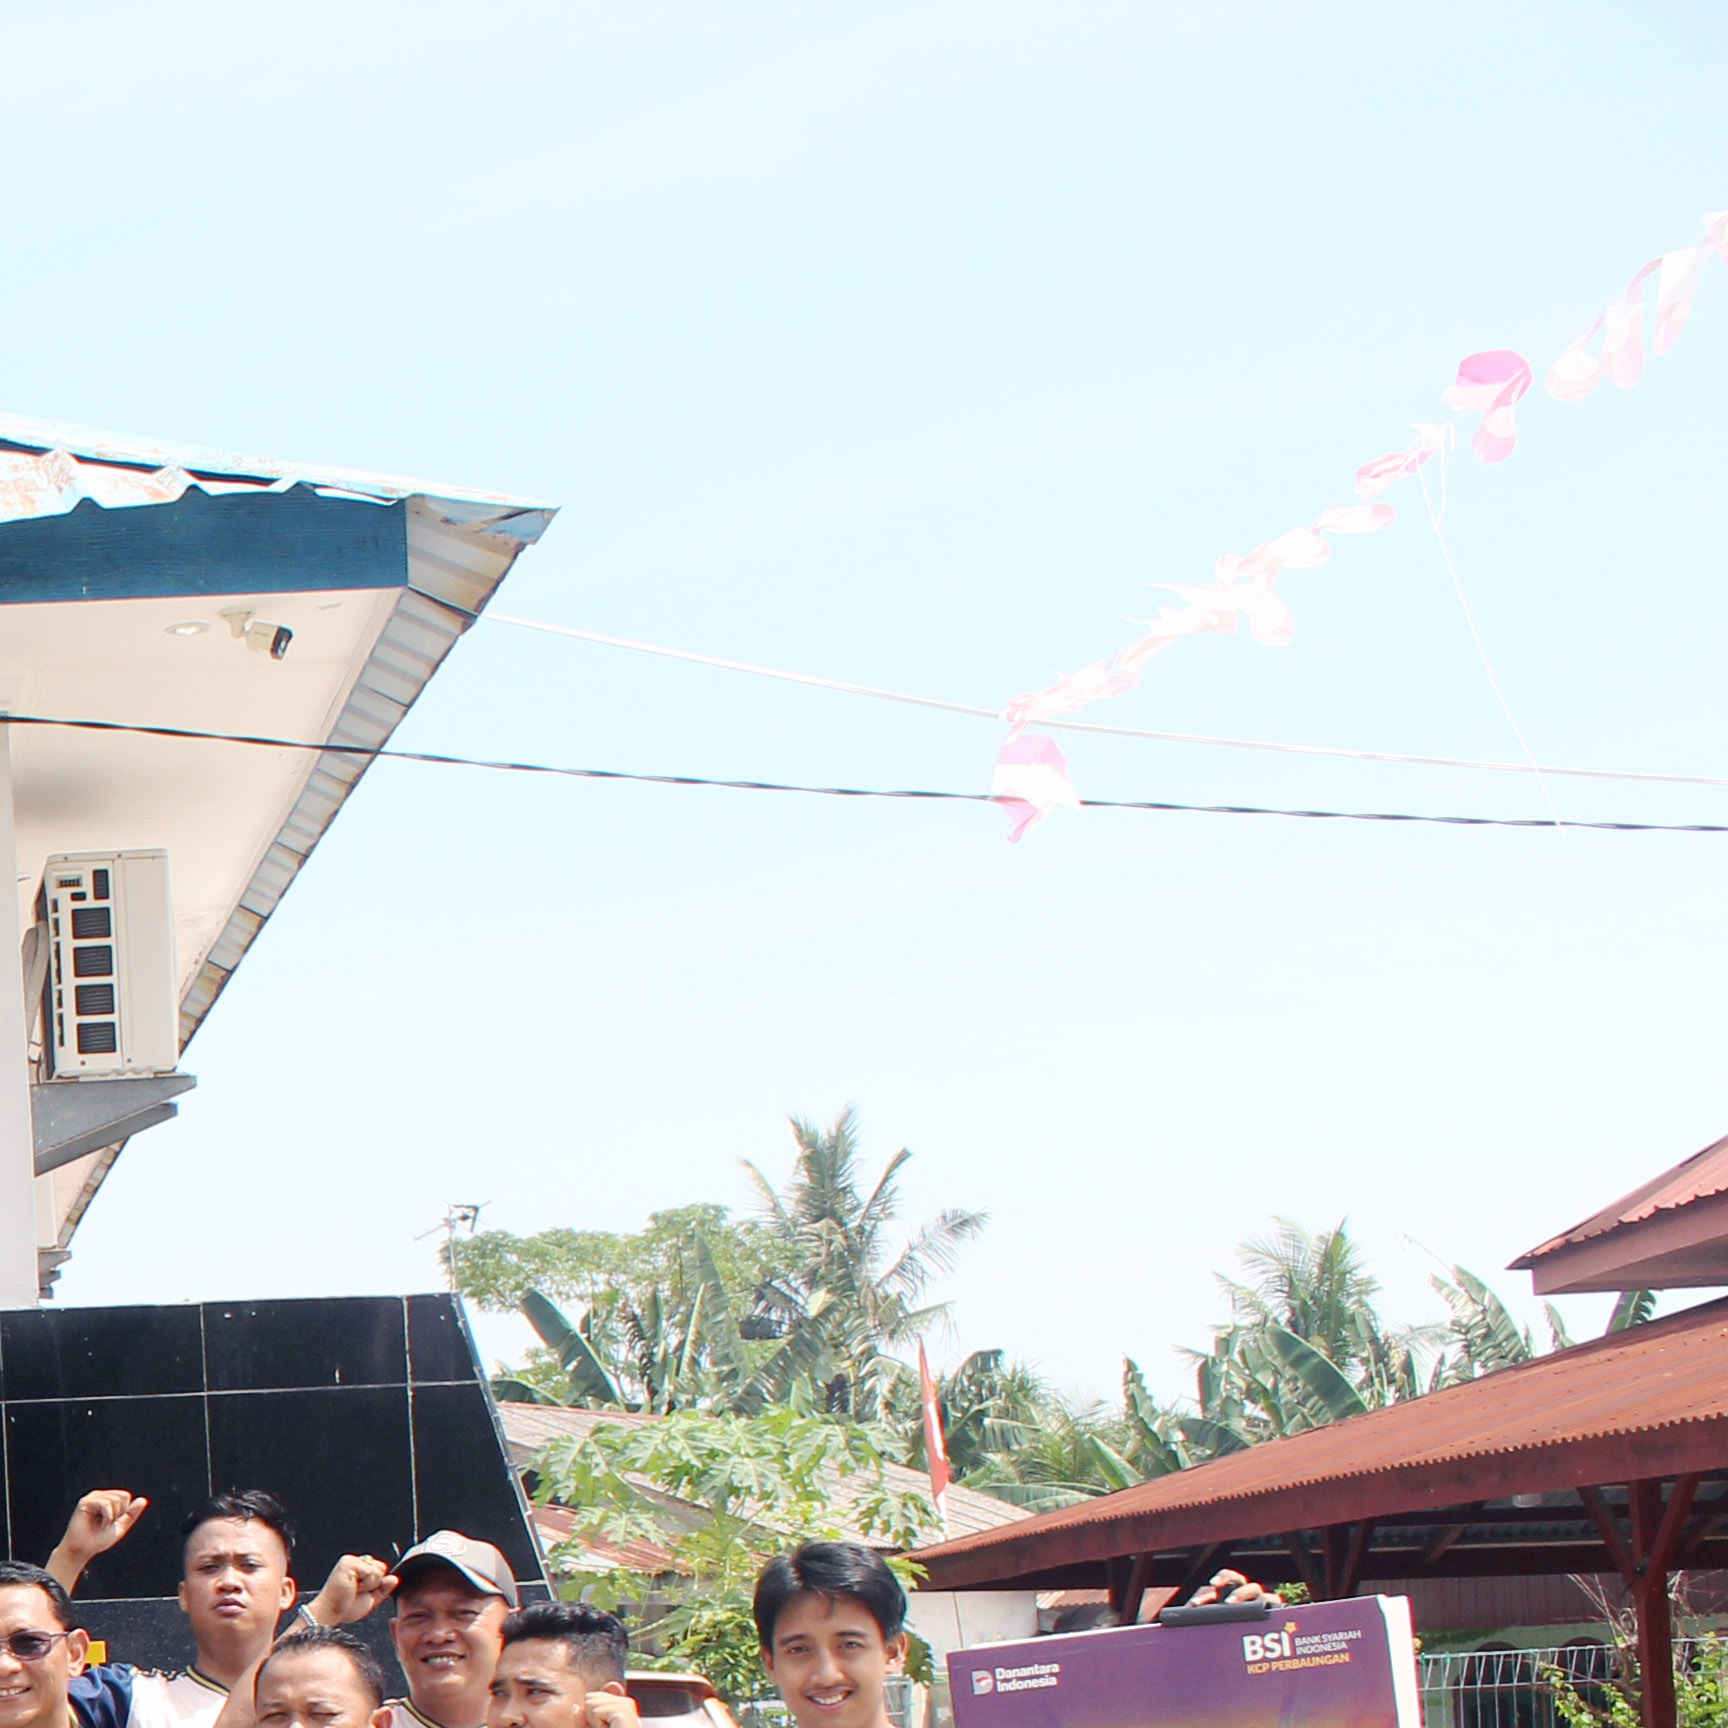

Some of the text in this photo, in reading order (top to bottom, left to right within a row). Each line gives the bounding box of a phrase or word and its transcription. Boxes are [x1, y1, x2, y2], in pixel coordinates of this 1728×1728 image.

[1242, 1631, 1292, 1662] BSI
[1294, 1630, 1362, 1646] BANK SYARIAH
[1296, 1641, 1348, 1655] INDONESIA
[994, 1663, 1060, 1680] Danantara
[1246, 1652, 1350, 1674] KCP PERBAUNGAN
[996, 1675, 1058, 1692] Indonesia
